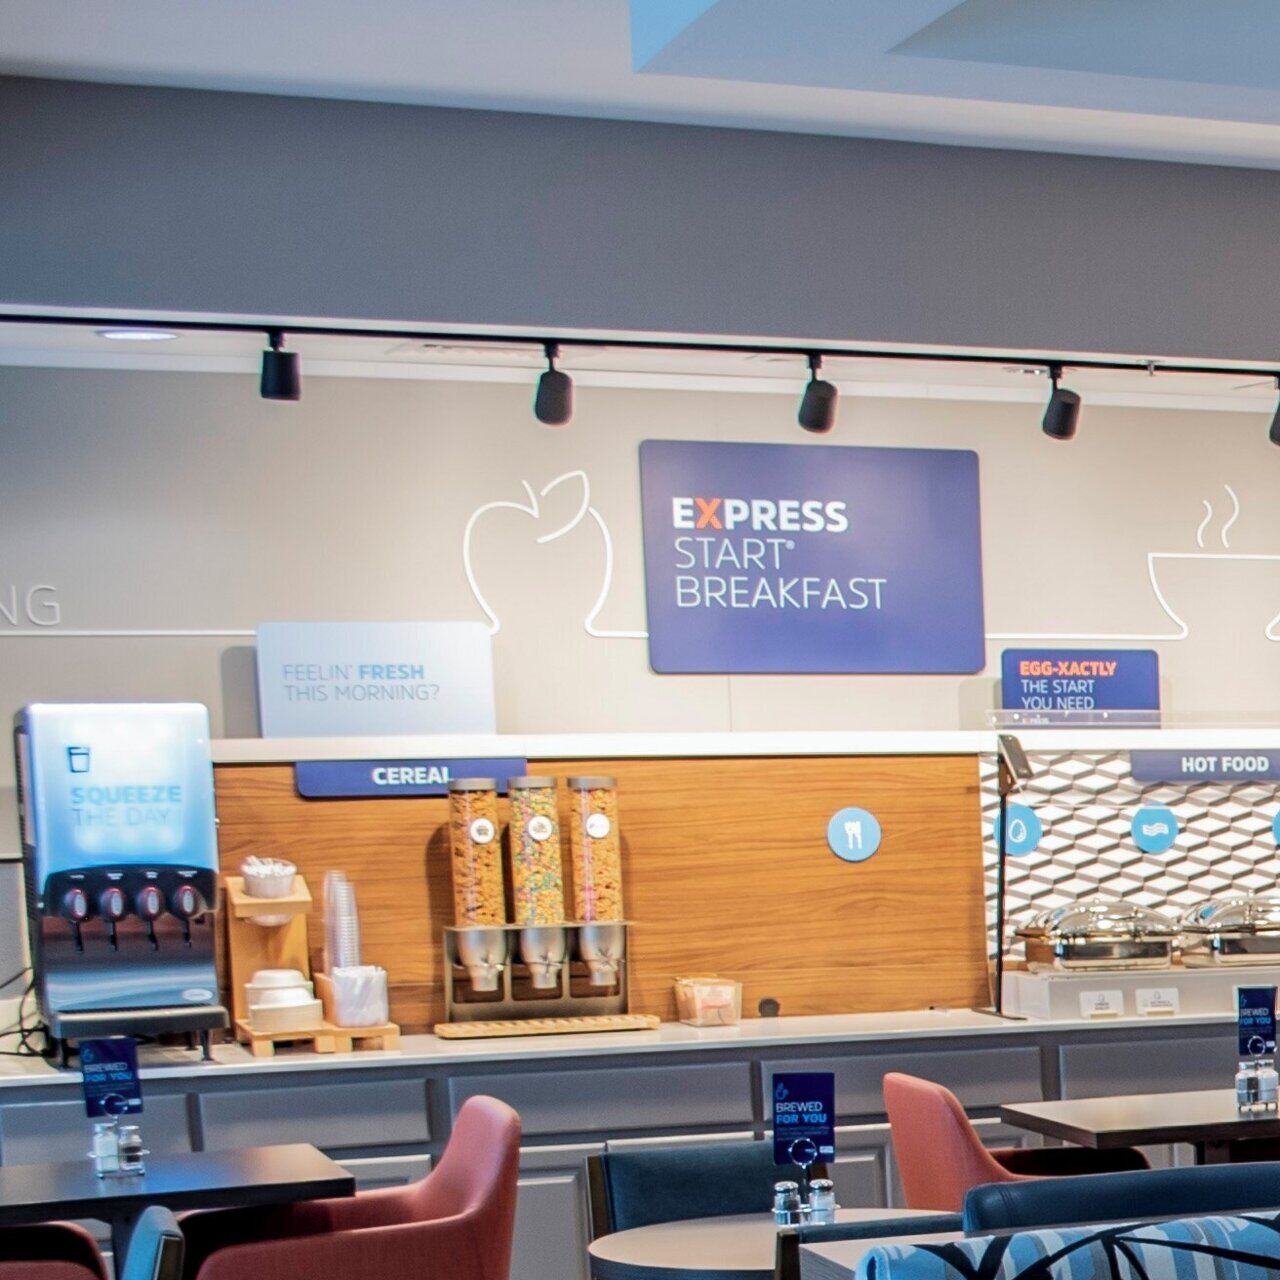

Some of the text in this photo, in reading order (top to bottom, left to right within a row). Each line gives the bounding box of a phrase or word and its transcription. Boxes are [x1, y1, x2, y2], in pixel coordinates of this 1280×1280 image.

[672, 497, 849, 532] EXPRESS
[676, 576, 888, 609] BREAKFAST
[359, 664, 425, 680] FRESH
[1019, 660, 1118, 676] EGG-XACTLY
[285, 684, 440, 701] THIS MORNING?
[1021, 679, 1095, 694] THE START
[1021, 696, 1095, 710] YOU NEED
[1182, 757, 1270, 773] HOT FOOD
[71, 785, 183, 805] SQUEEZE
[72, 807, 172, 826] THE DAY
[1256, 1017, 1271, 1025] YOU
[776, 1101, 823, 1113] BREWED
[776, 1113, 827, 1124] FOR YOU
